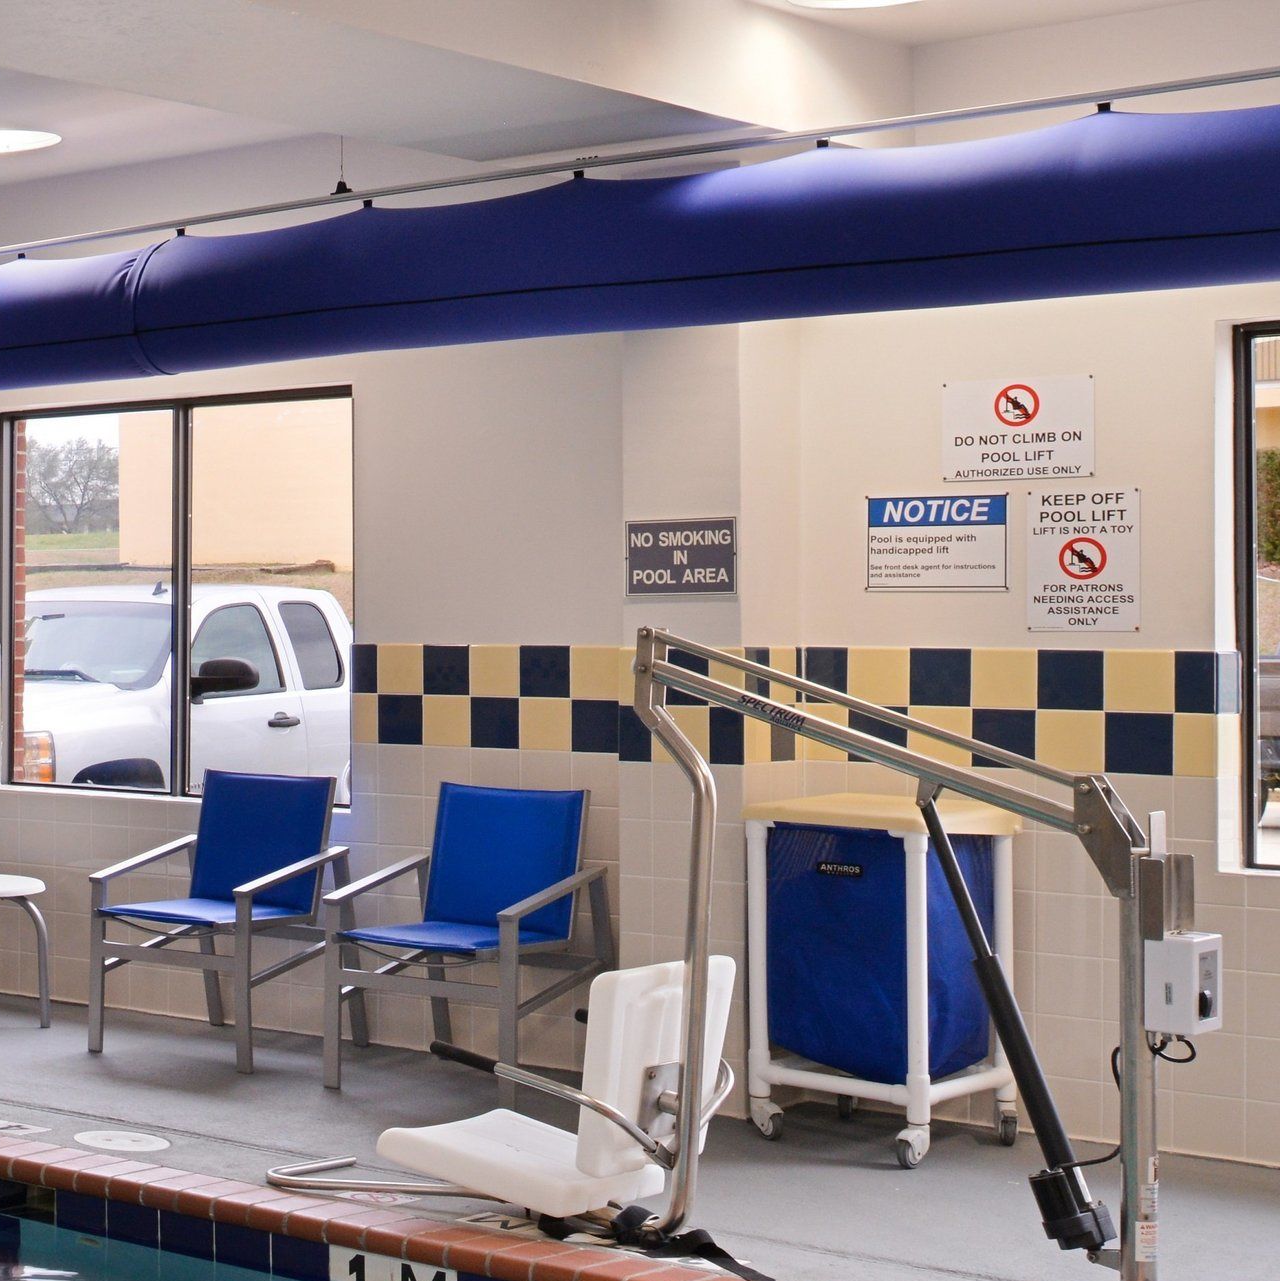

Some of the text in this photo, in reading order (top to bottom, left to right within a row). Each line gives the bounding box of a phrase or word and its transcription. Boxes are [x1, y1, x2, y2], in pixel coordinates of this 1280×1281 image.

[955, 431, 1082, 446] DO NOT CLIMB ON
[982, 450, 1054, 462] POOL LIFT
[955, 466, 1081, 478] AUTHORIZED USE ONLY
[1042, 493, 1124, 506] KEEP OFF
[883, 499, 990, 522] NOTICE
[1040, 510, 1126, 522] POOL LIFT
[1033, 527, 1055, 535] LIFT
[1074, 526, 1096, 534] NOT
[1111, 525, 1133, 533] TOY
[631, 529, 731, 547] NO SMOKING
[907, 534, 952, 544] equipped
[956, 534, 976, 542] with
[674, 550, 687, 564] IN
[871, 546, 949, 556] handicapped lift
[633, 568, 729, 584] POOL AREA
[1044, 584, 1123, 592] FOR PATRONS
[1087, 595, 1134, 603] ACCESS
[739, 695, 806, 725] SPECTRUM
